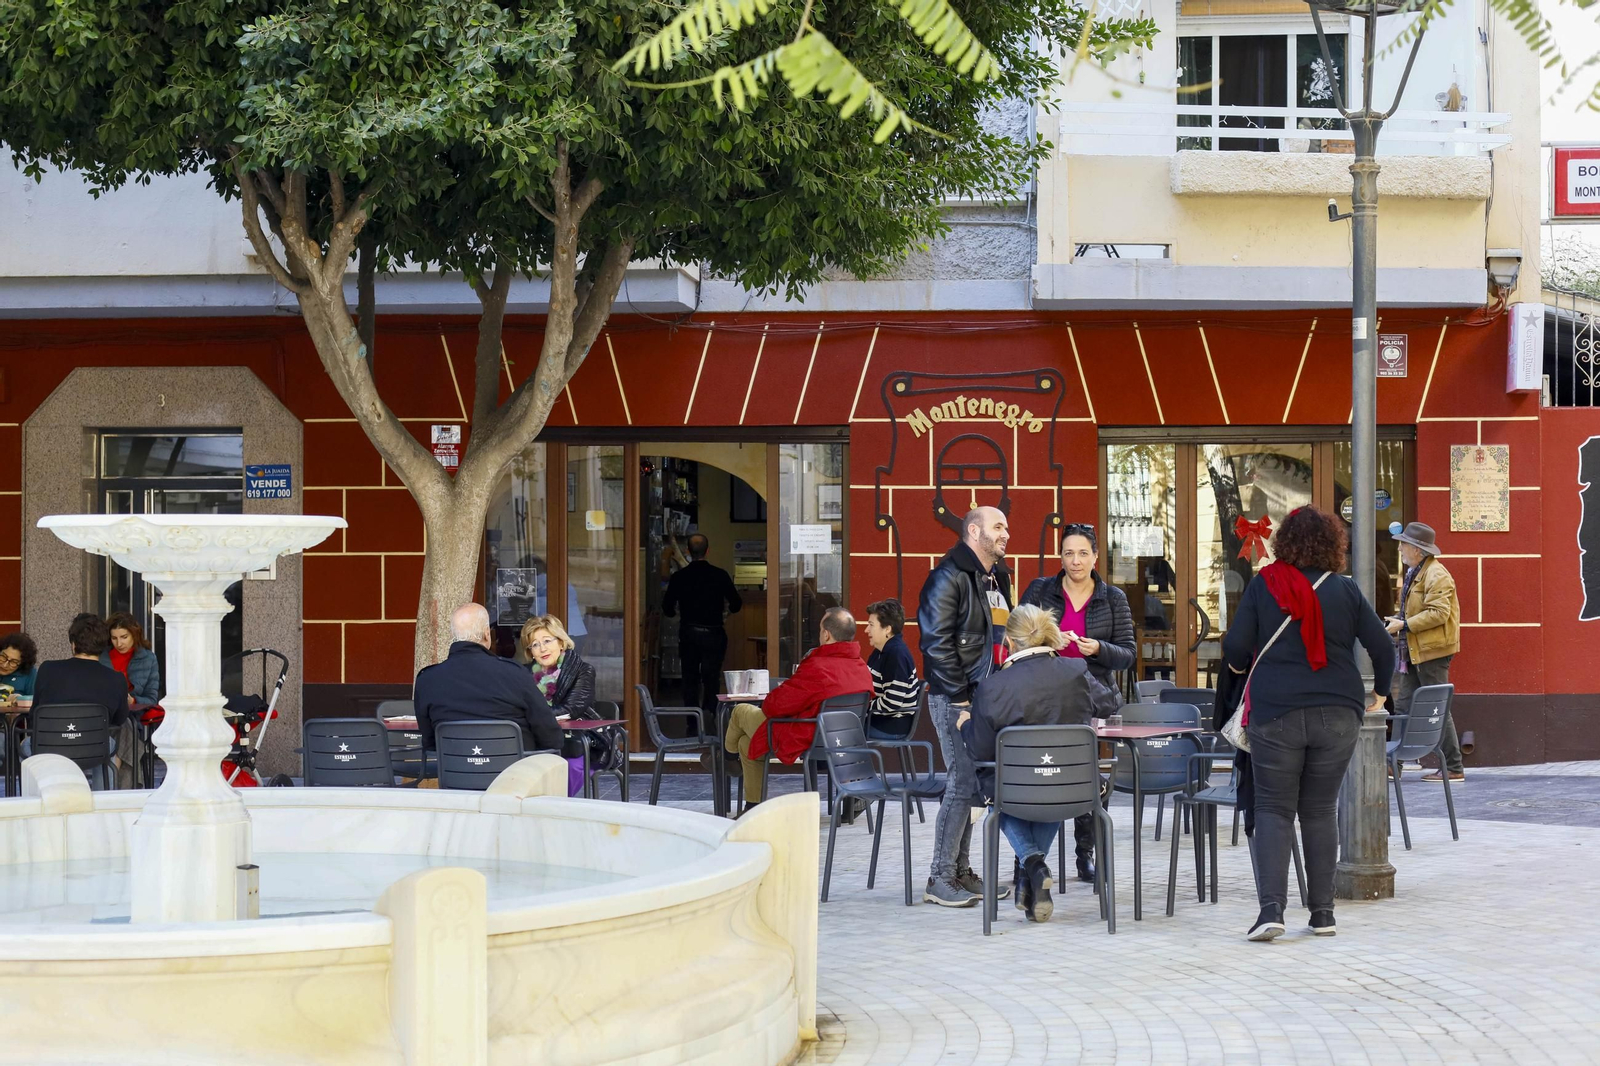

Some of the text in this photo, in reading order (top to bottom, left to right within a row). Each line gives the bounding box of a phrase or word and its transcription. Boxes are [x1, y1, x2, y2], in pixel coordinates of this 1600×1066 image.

[1578, 165, 1600, 177] BO
[157, 393, 166, 407] 3
[905, 394, 1044, 438] Montenegro
[250, 479, 287, 488] VENDE
[247, 488, 291, 498] 619 177 000
